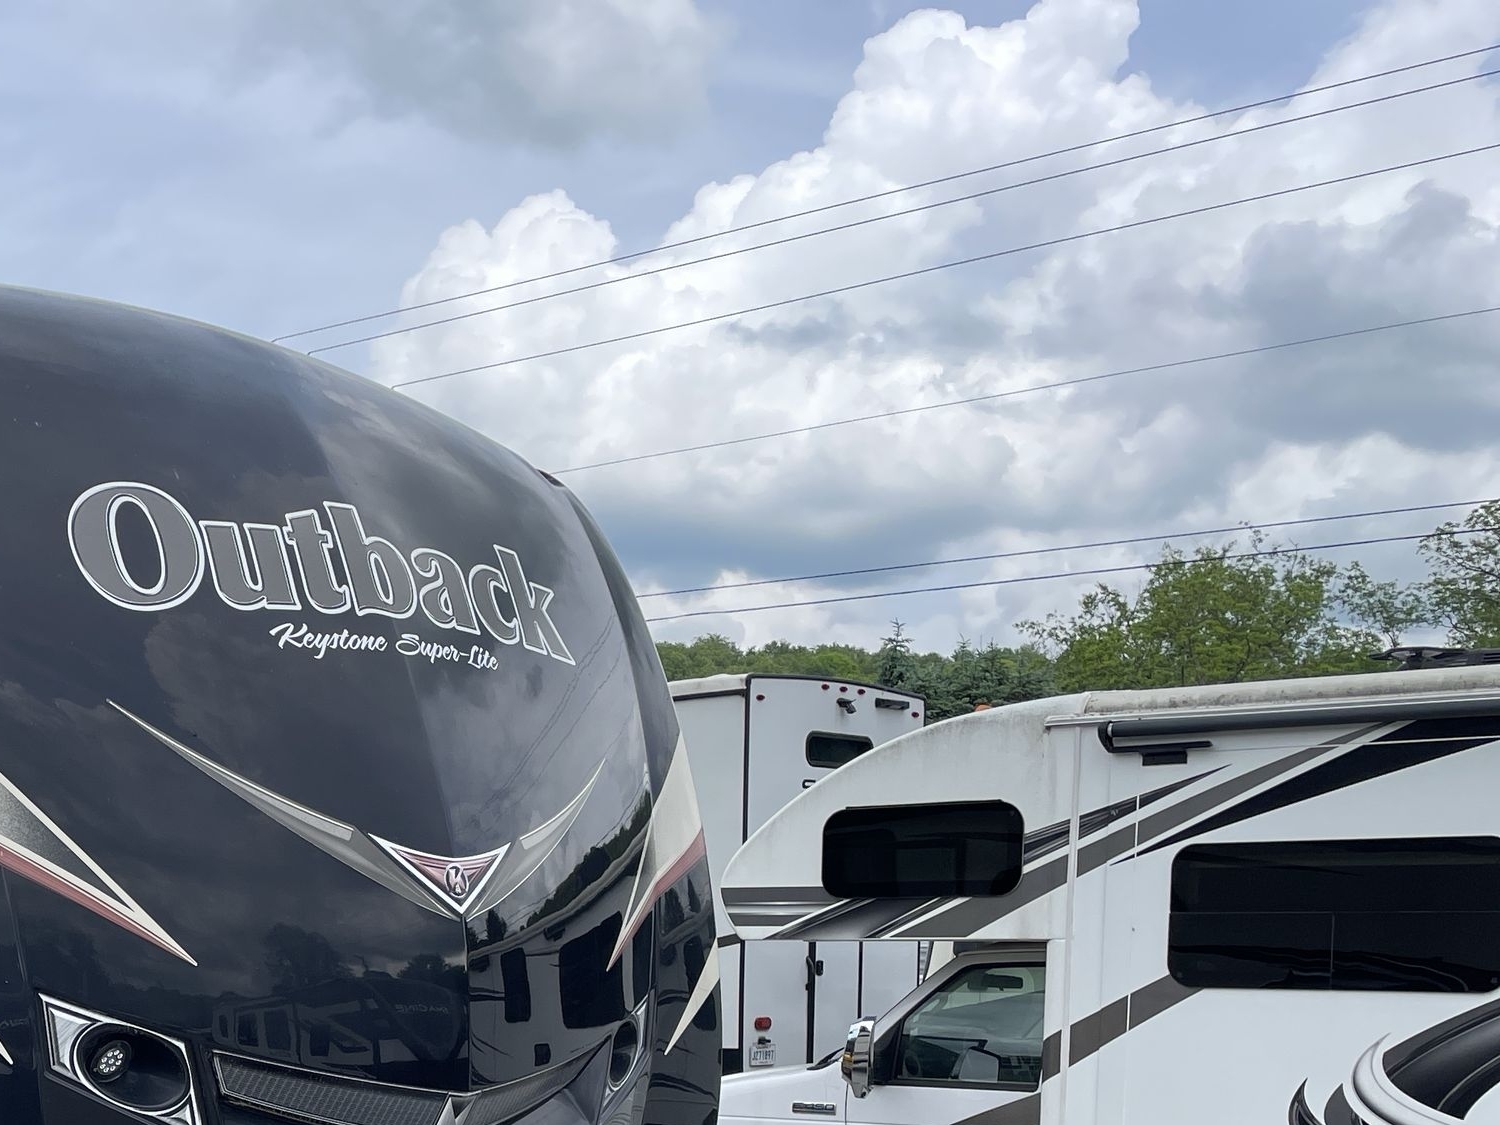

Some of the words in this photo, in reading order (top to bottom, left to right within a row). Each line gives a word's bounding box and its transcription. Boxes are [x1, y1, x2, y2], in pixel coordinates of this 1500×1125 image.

[67, 481, 576, 666] Outback
[269, 622, 388, 662] Keystone
[395, 632, 499, 671] Super-Lite
